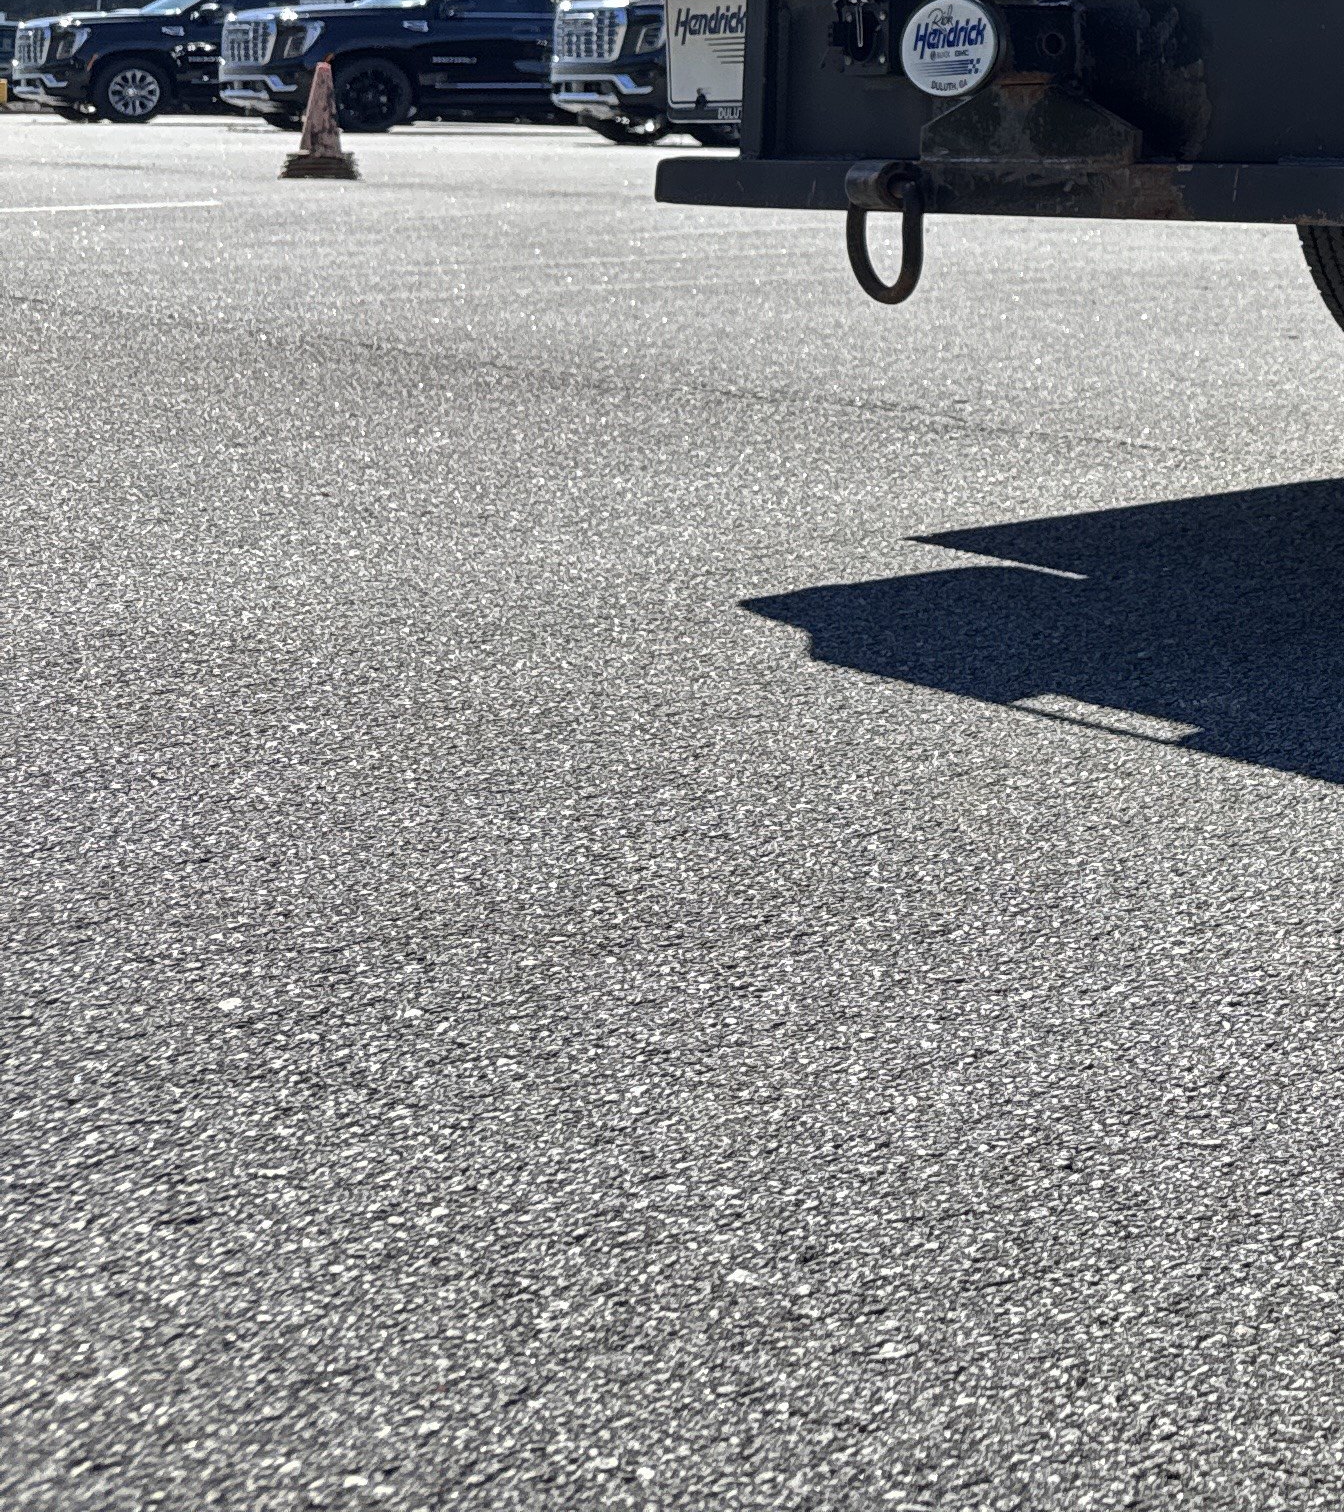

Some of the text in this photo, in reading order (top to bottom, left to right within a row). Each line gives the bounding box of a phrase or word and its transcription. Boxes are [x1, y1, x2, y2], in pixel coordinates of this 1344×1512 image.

[674, 4, 746, 46] Hendrick
[928, 4, 954, 29] Rick
[913, 17, 986, 60] Hendrick
[717, 106, 742, 120] DULUT
